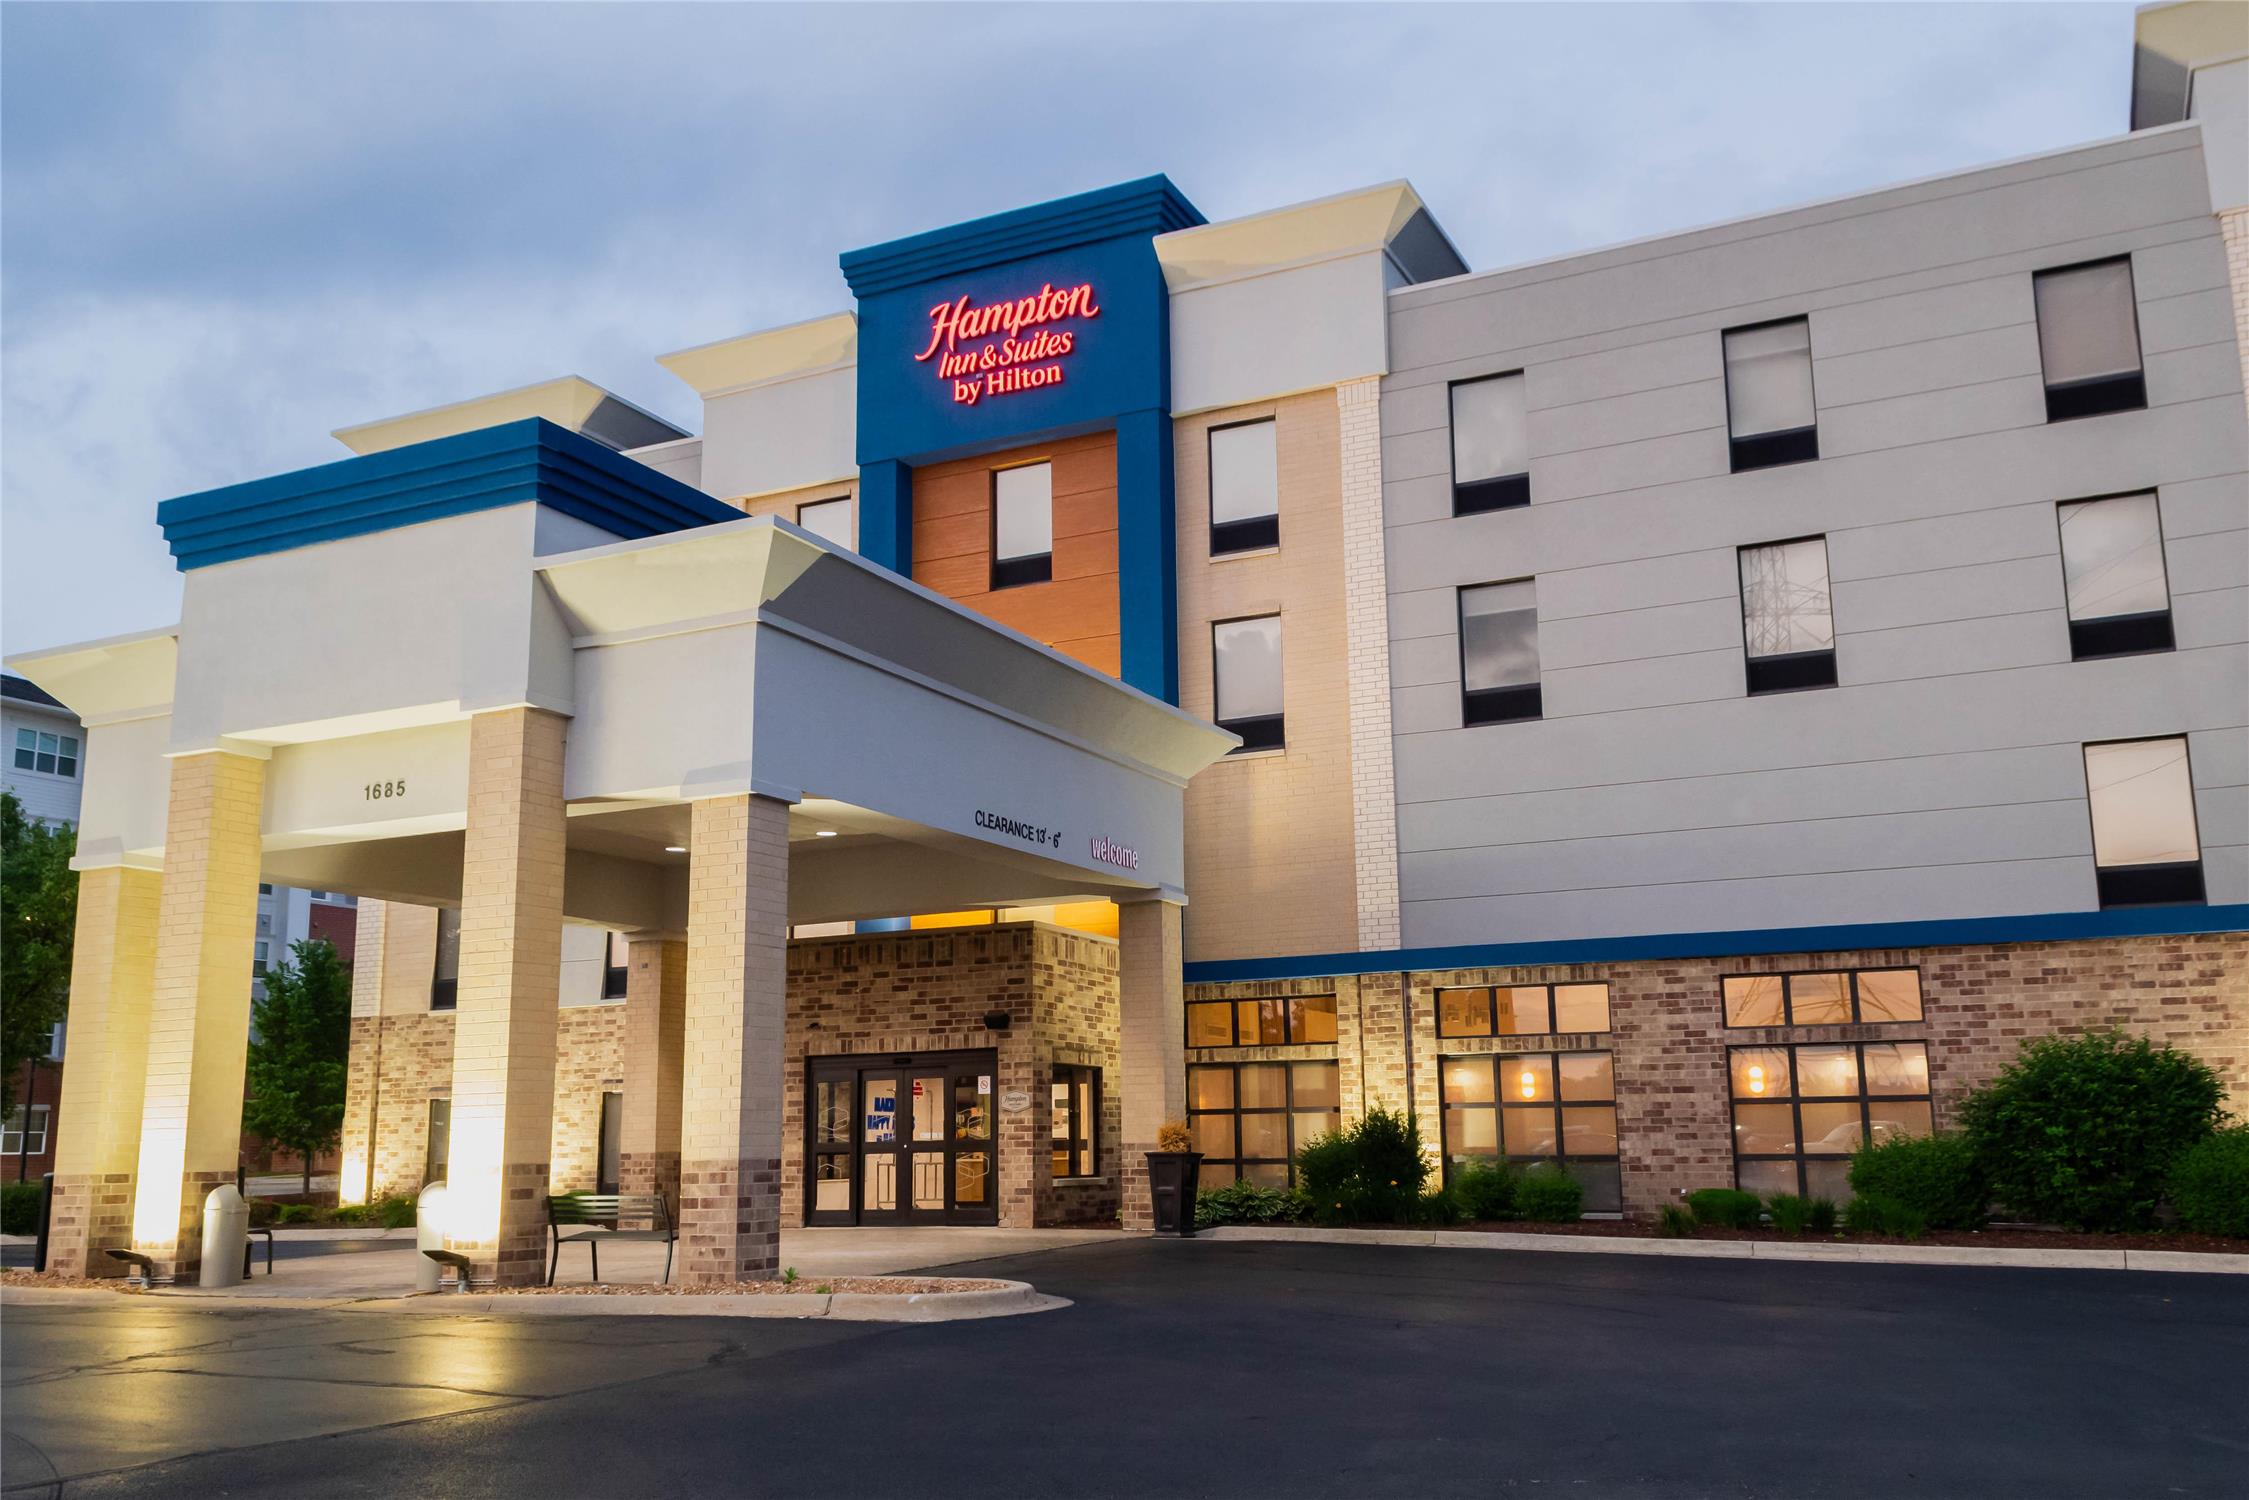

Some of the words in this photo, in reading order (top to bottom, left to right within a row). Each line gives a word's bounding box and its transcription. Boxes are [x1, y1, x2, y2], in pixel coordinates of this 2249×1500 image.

[914, 283, 1099, 361] Hampton
[938, 351, 978, 379] Inn
[998, 330, 1074, 366] Suites
[954, 379, 982, 405] by
[987, 364, 1062, 396] Hilton
[364, 780, 406, 801] 1685
[974, 809, 1035, 842] CLEARANCE
[1090, 836, 1139, 871] welcome
